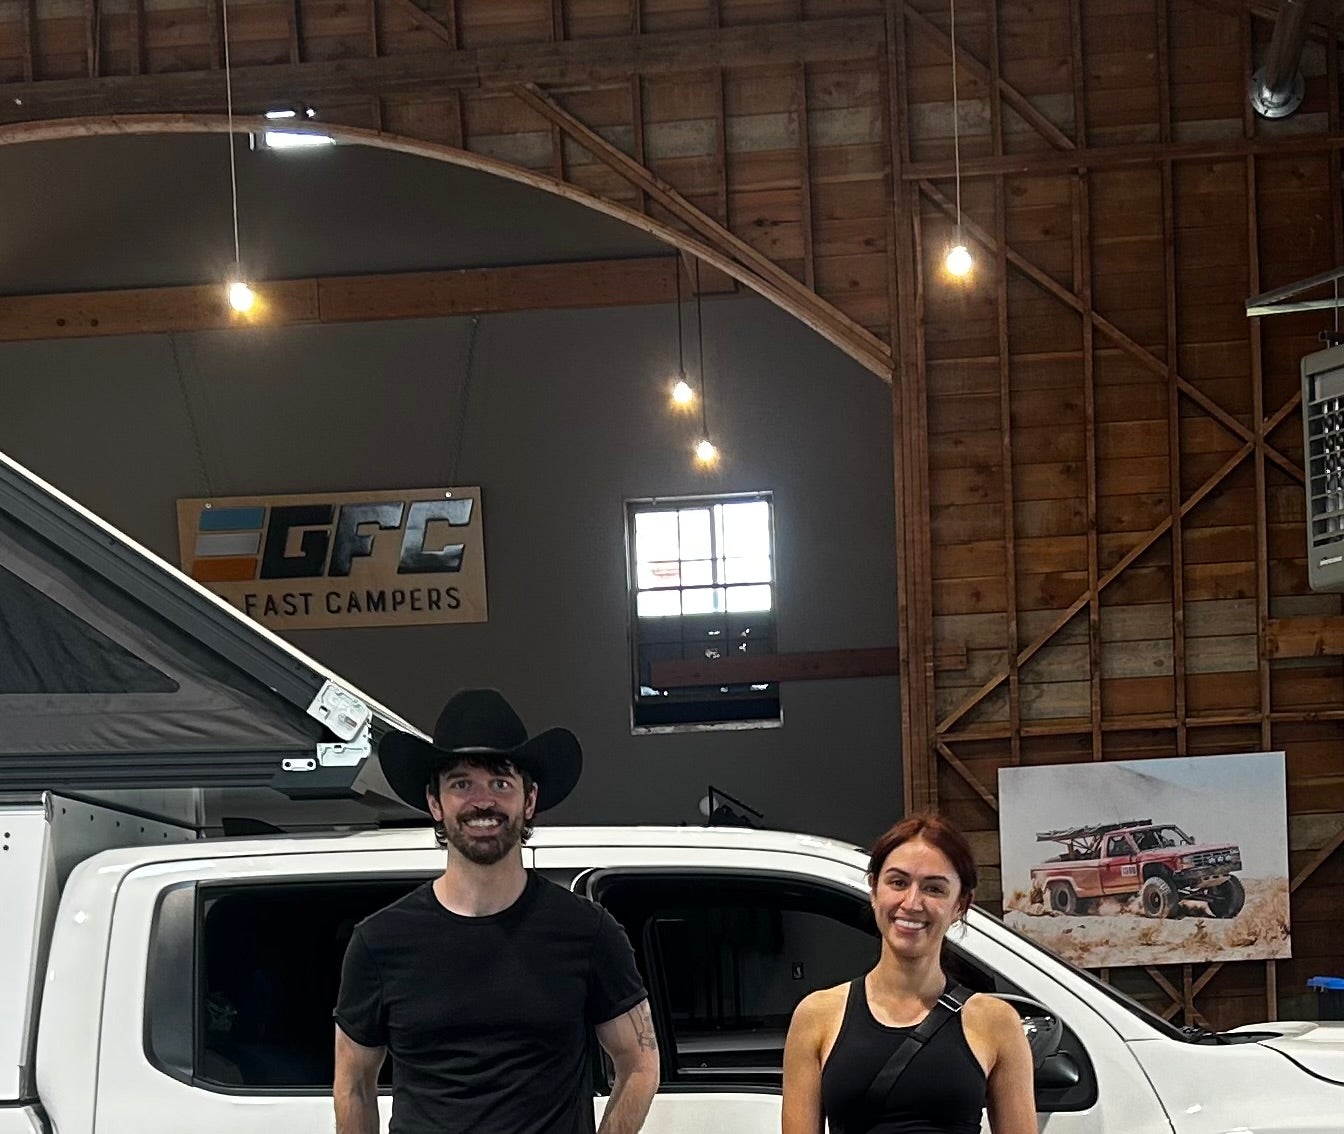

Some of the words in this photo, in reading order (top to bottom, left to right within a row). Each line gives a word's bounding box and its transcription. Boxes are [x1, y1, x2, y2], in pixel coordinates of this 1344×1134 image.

[260, 498, 473, 580] GFC
[245, 592, 312, 616] FAST
[326, 587, 462, 614] CAMPERS
